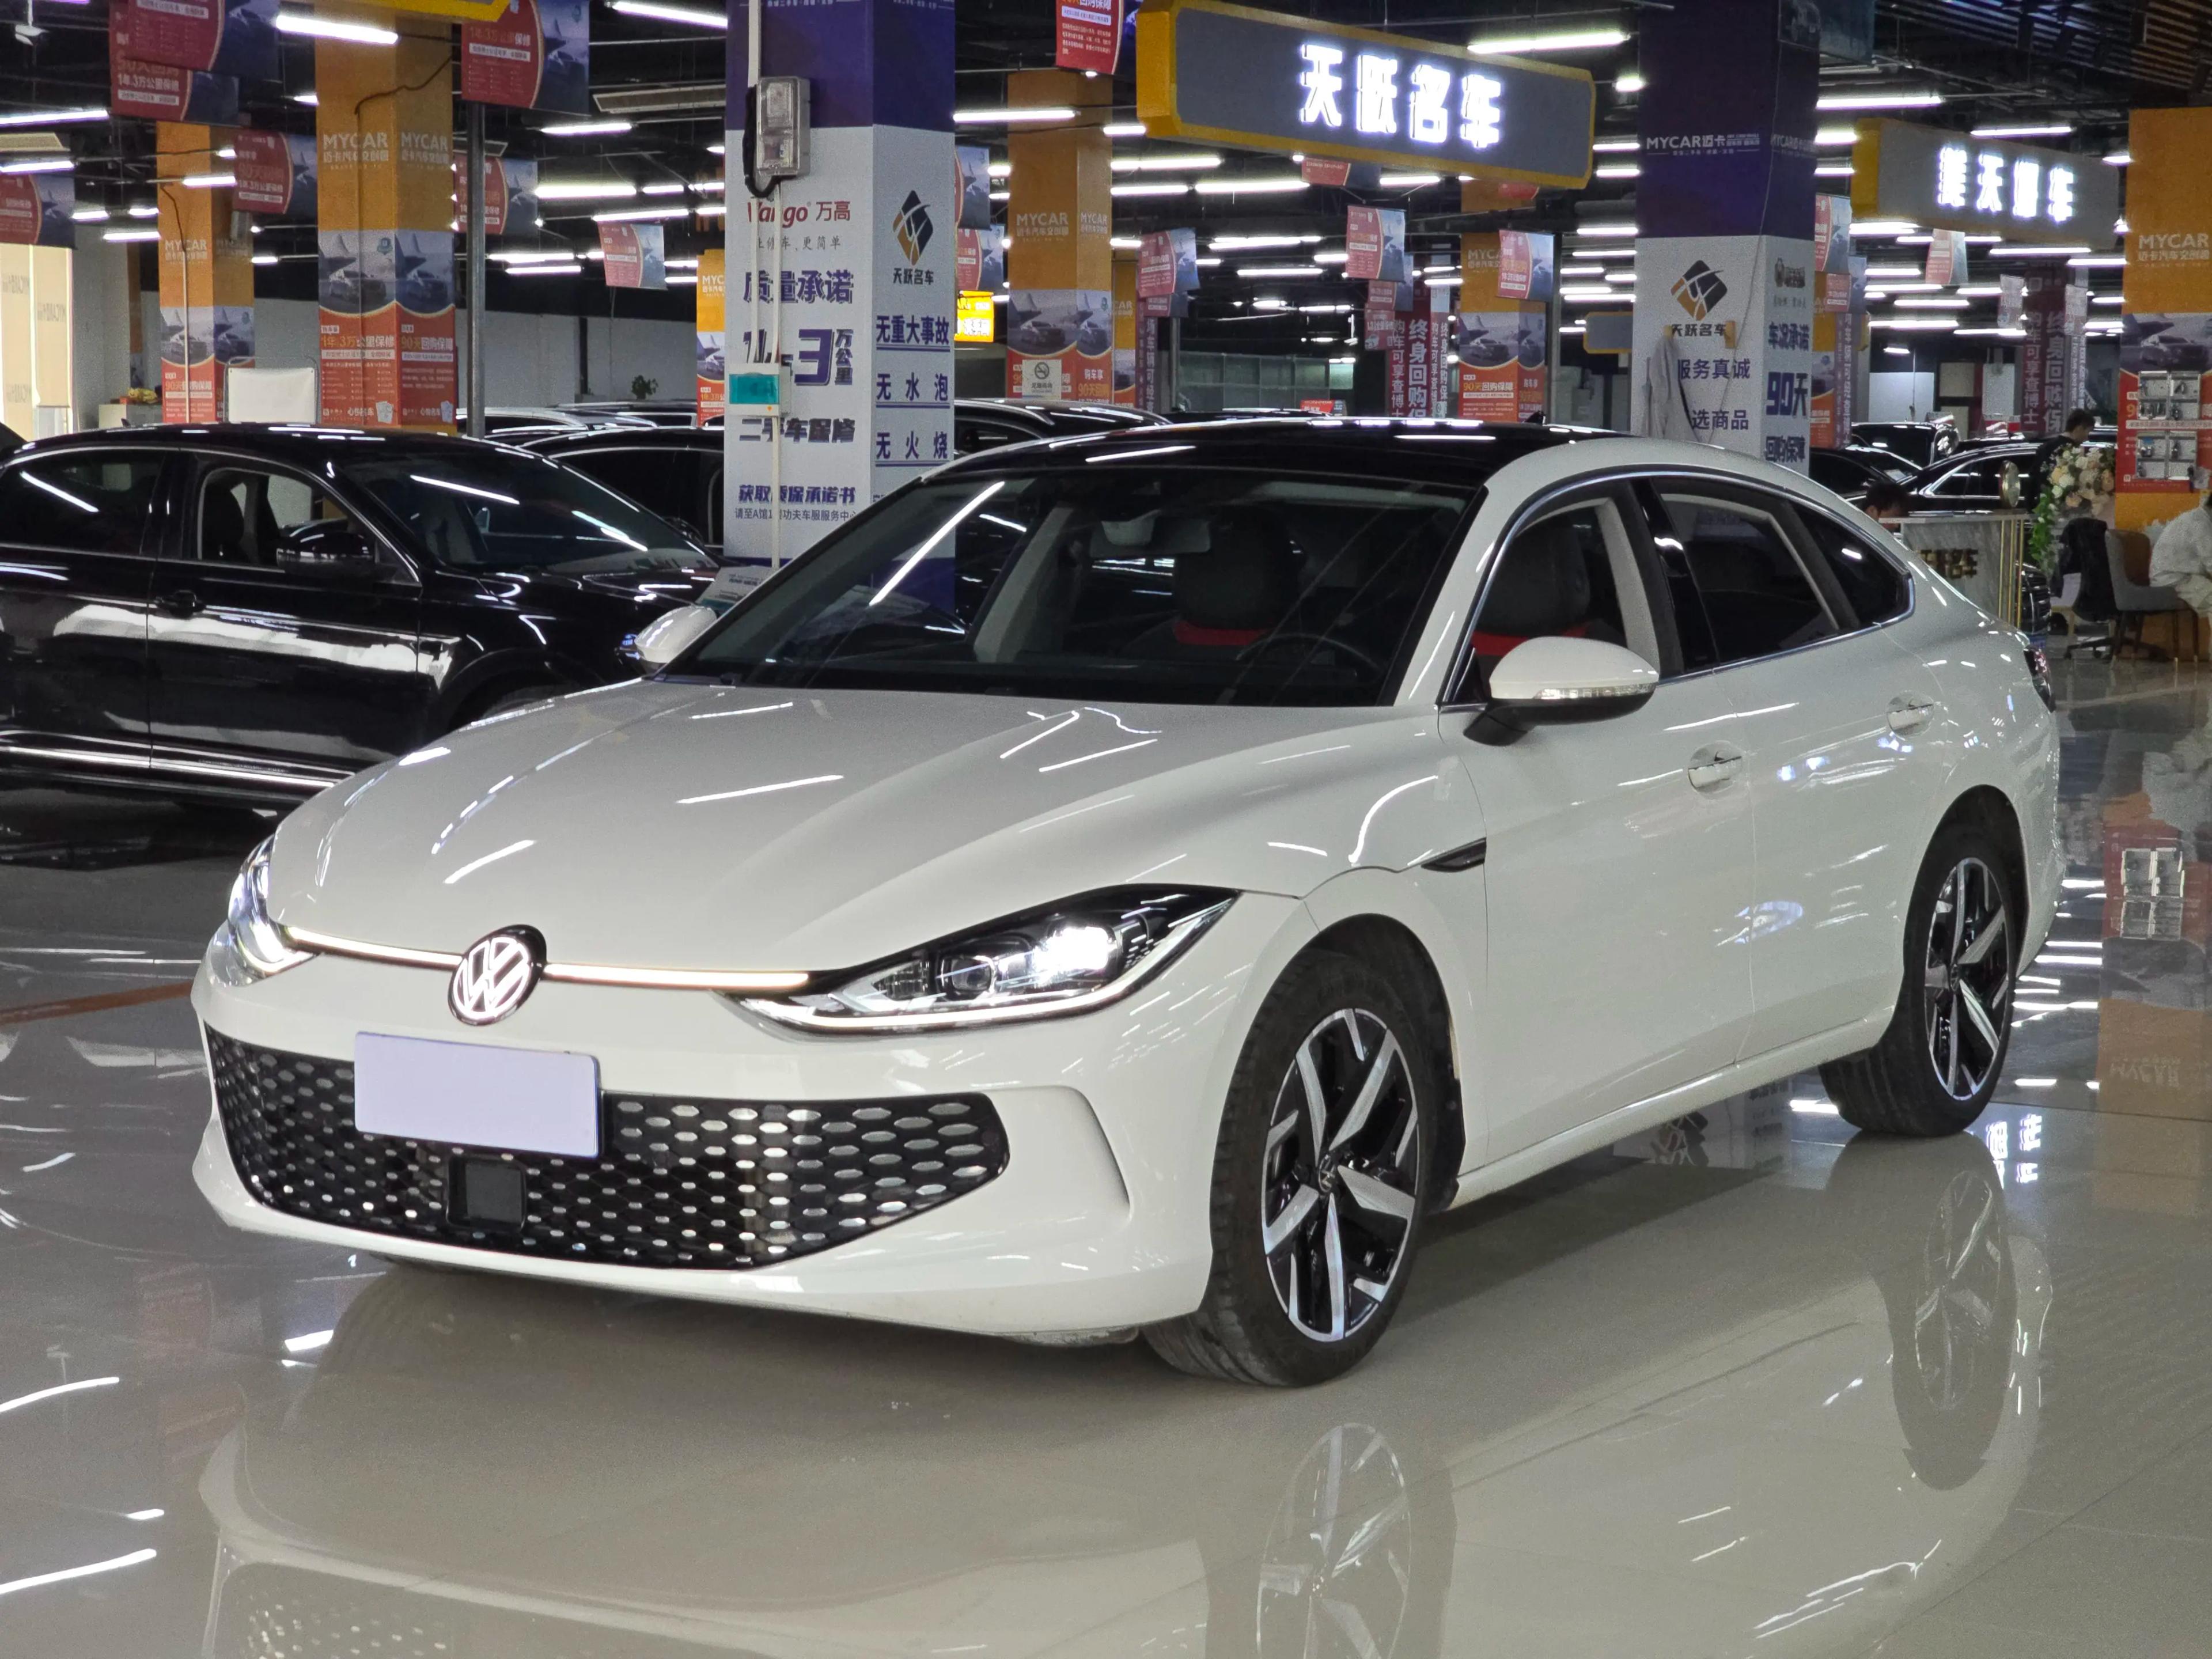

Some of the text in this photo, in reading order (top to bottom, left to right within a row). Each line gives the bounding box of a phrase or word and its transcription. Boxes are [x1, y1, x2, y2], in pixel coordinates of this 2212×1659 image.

[1300, 44, 1502, 148] 天跃名车
[323, 132, 389, 149] MYCAR
[402, 132, 449, 151] MYCAR
[816, 201, 851, 222] 万高
[1017, 213, 1069, 226] MYCAR
[2139, 233, 2210, 249] MYCAR
[1468, 249, 1501, 260] MYC
[703, 275, 724, 285] MYC
[893, 267, 934, 285] 天跃名车
[743, 270, 854, 304] 质量承诺
[876, 315, 949, 345] 无重大事故
[1672, 324, 1726, 336] 天跃名车
[1677, 358, 1751, 380] 服务真诚
[876, 372, 949, 402] 无水泡
[1766, 372, 1808, 418] 90天
[1692, 409, 1749, 430] 选商品
[876, 431, 948, 460] 无火烧
[735, 507, 856, 522] 请至A馆1功夫车服服务中心
